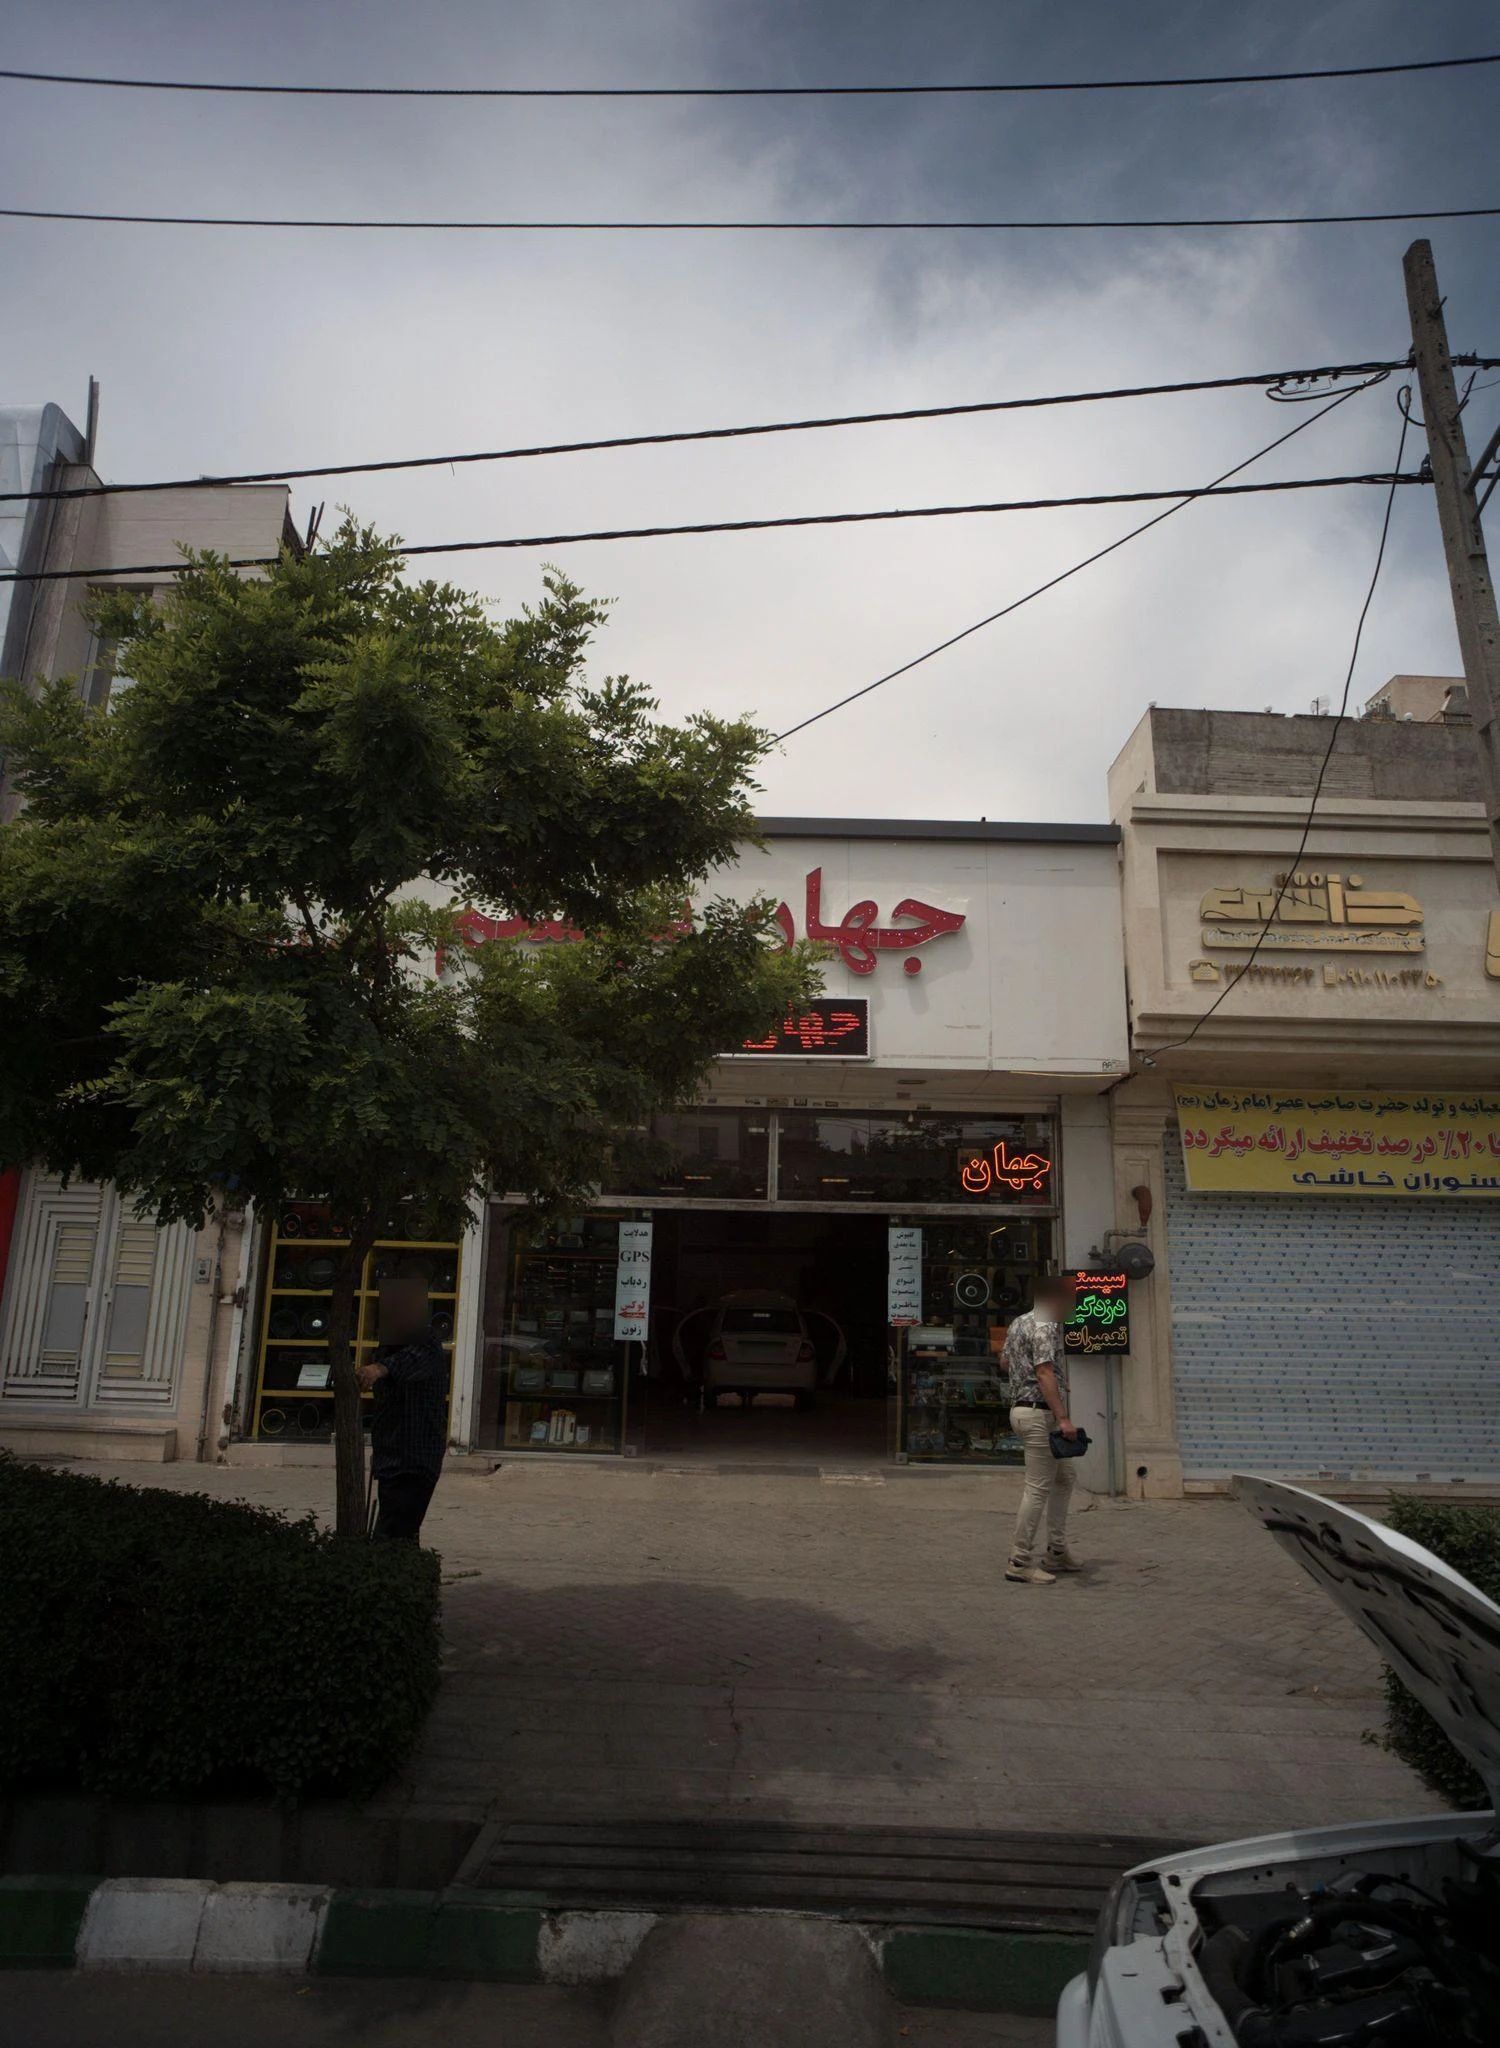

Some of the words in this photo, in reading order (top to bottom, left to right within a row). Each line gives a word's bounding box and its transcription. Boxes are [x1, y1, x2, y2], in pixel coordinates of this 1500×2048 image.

[1203, 1092, 1240, 1114] زمان
[1242, 1094, 1271, 1112] امام
[1273, 1096, 1305, 1114] عصر
[1307, 1094, 1356, 1116] صاحب
[1358, 1094, 1410, 1117] حضرت
[1413, 1095, 1446, 1118] تولد
[1449, 1103, 1457, 1117] و
[1257, 1124, 1306, 1160] ارائه
[1306, 1128, 1375, 1160] تخفیف
[962, 1141, 1051, 1193] جهان
[1402, 1170, 1500, 1191] ستوران
[620, 1250, 649, 1263] GPS
[620, 1275, 647, 1289] ردیاب
[896, 1277, 915, 1286] انواع
[1075, 1271, 1127, 1294] سیست
[621, 1323, 642, 1336] زنون
[1064, 1325, 1127, 1353] تعمیرات
